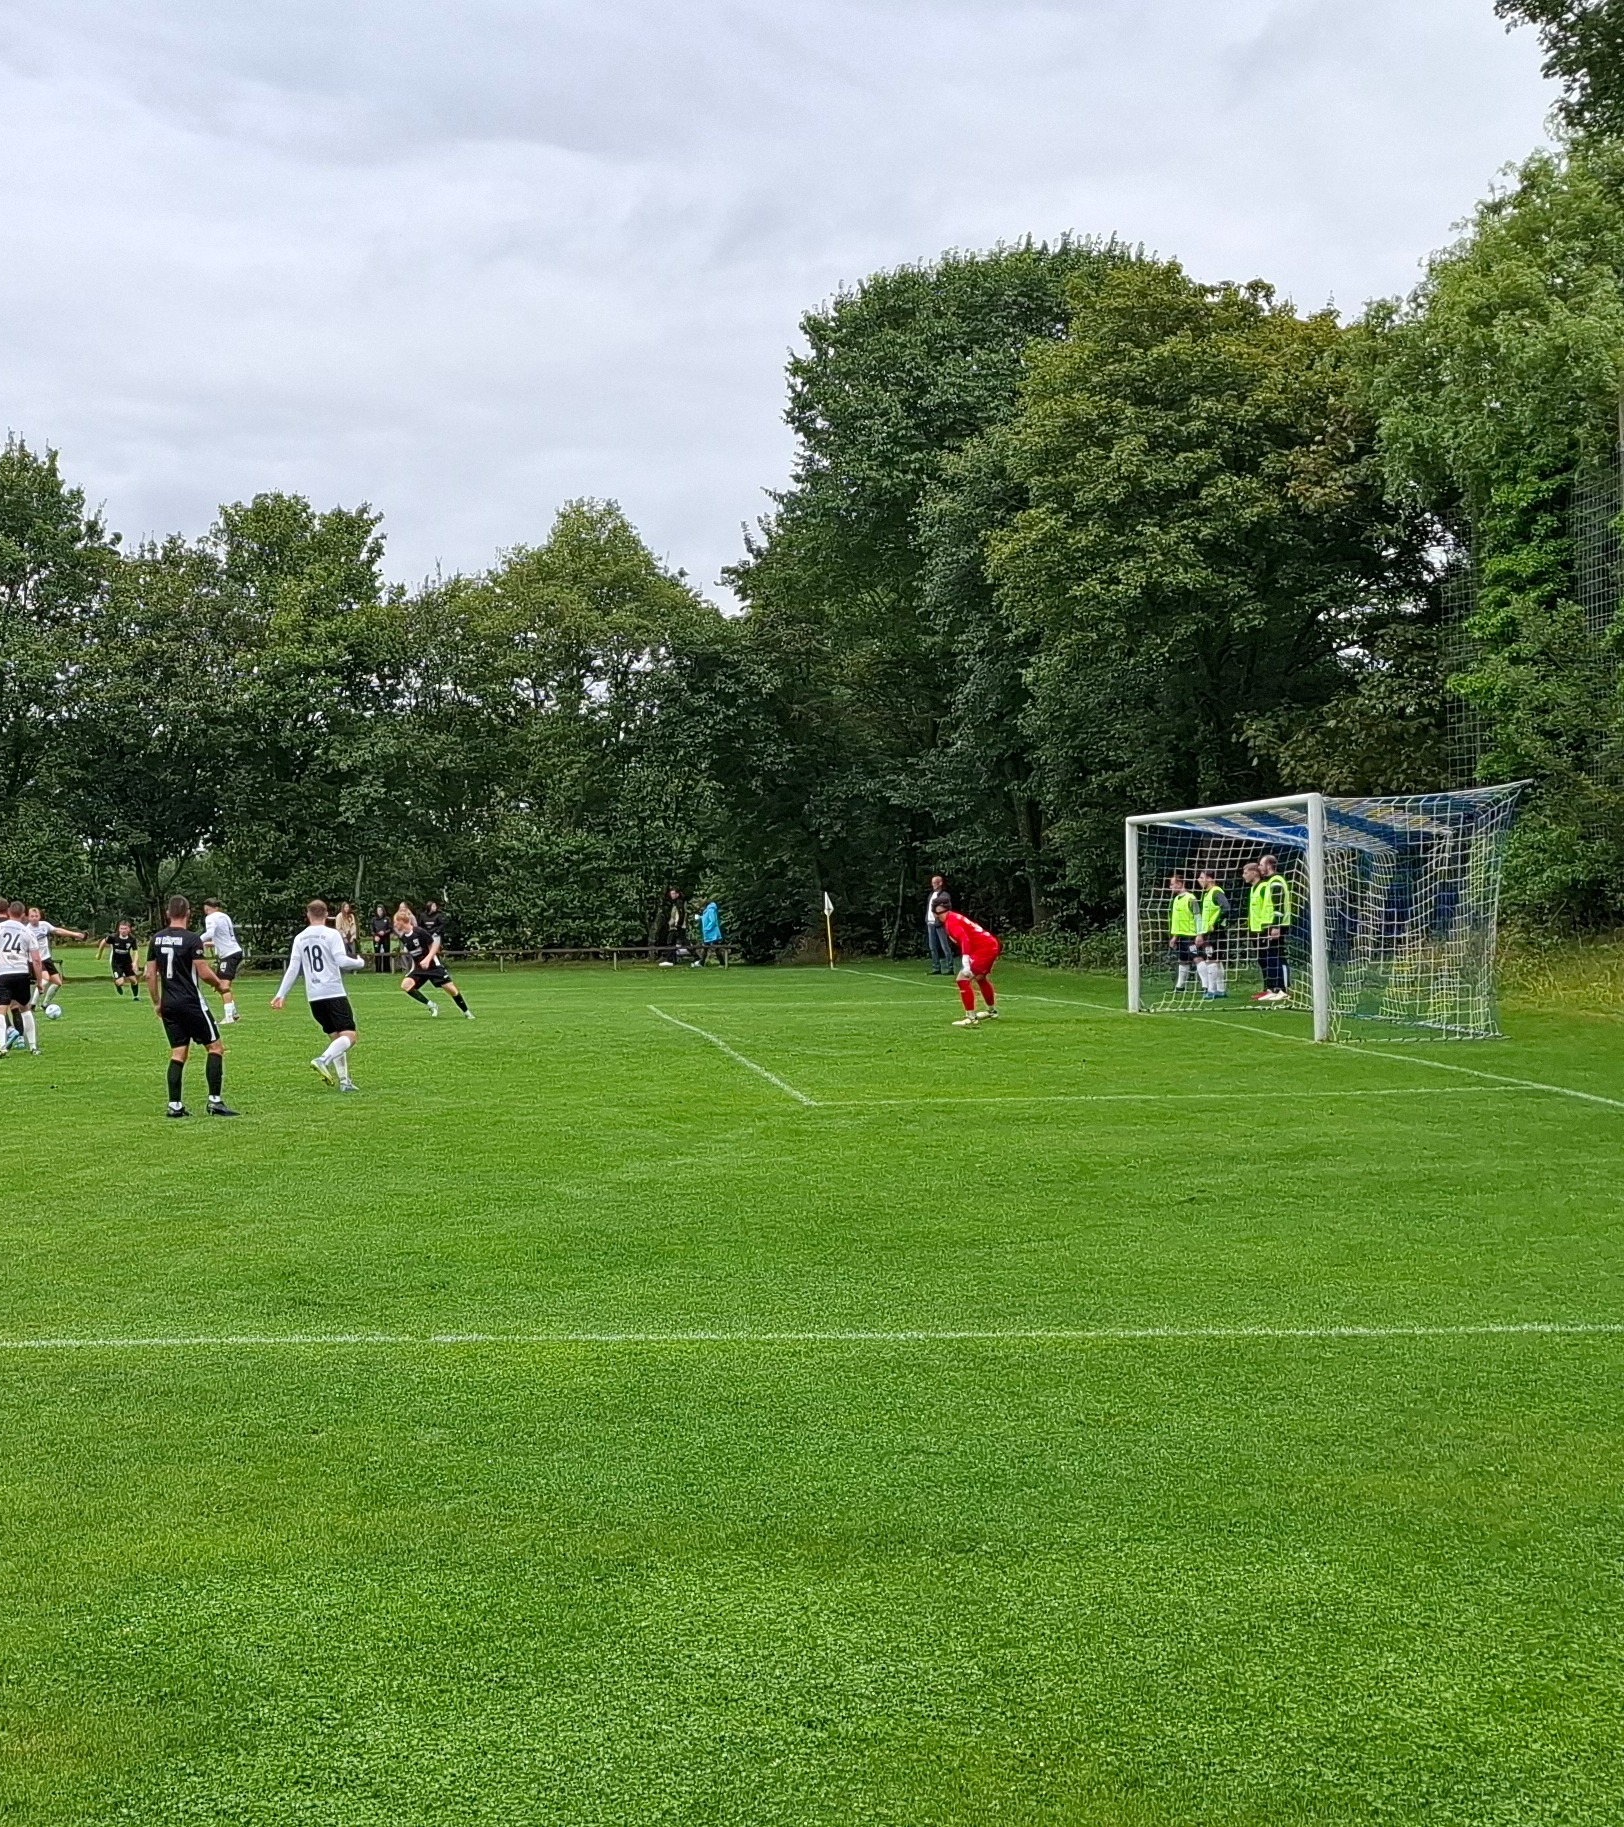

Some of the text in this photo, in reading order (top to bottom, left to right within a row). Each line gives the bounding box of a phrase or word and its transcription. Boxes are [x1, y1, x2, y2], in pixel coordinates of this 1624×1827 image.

[2, 933, 21, 954] 24
[161, 946, 174, 979] 7
[304, 944, 324, 973] 18
